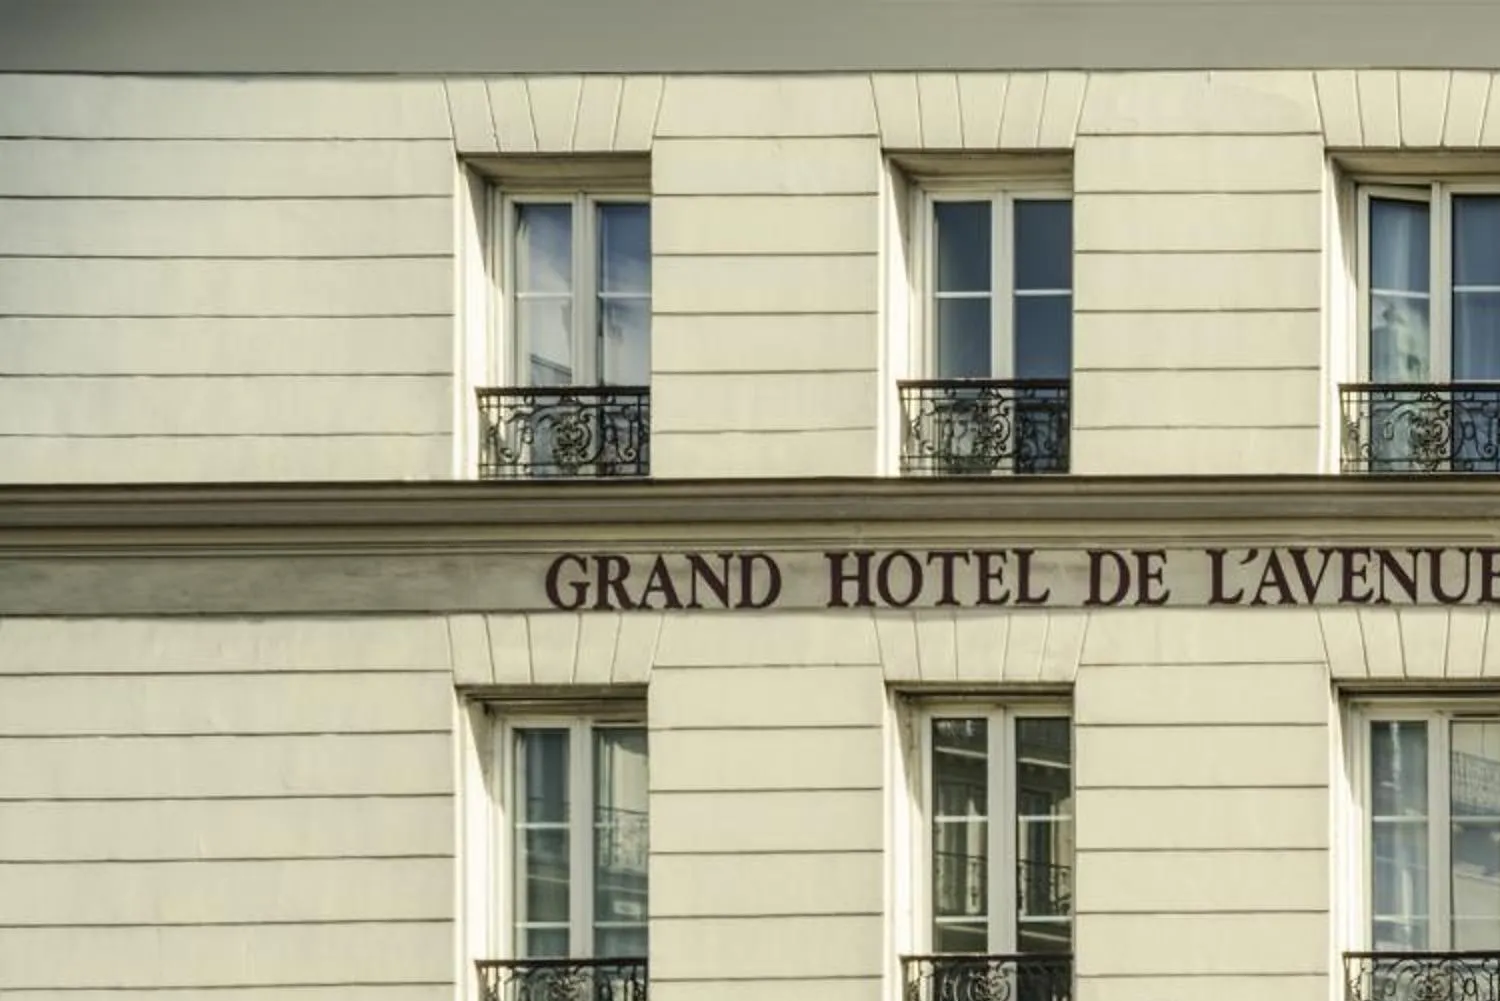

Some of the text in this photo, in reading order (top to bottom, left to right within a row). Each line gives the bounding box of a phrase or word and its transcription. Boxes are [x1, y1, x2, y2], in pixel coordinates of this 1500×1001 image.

[545, 552, 782, 611] GRAND
[824, 548, 1050, 609] HOTEL
[1084, 548, 1170, 607] DE
